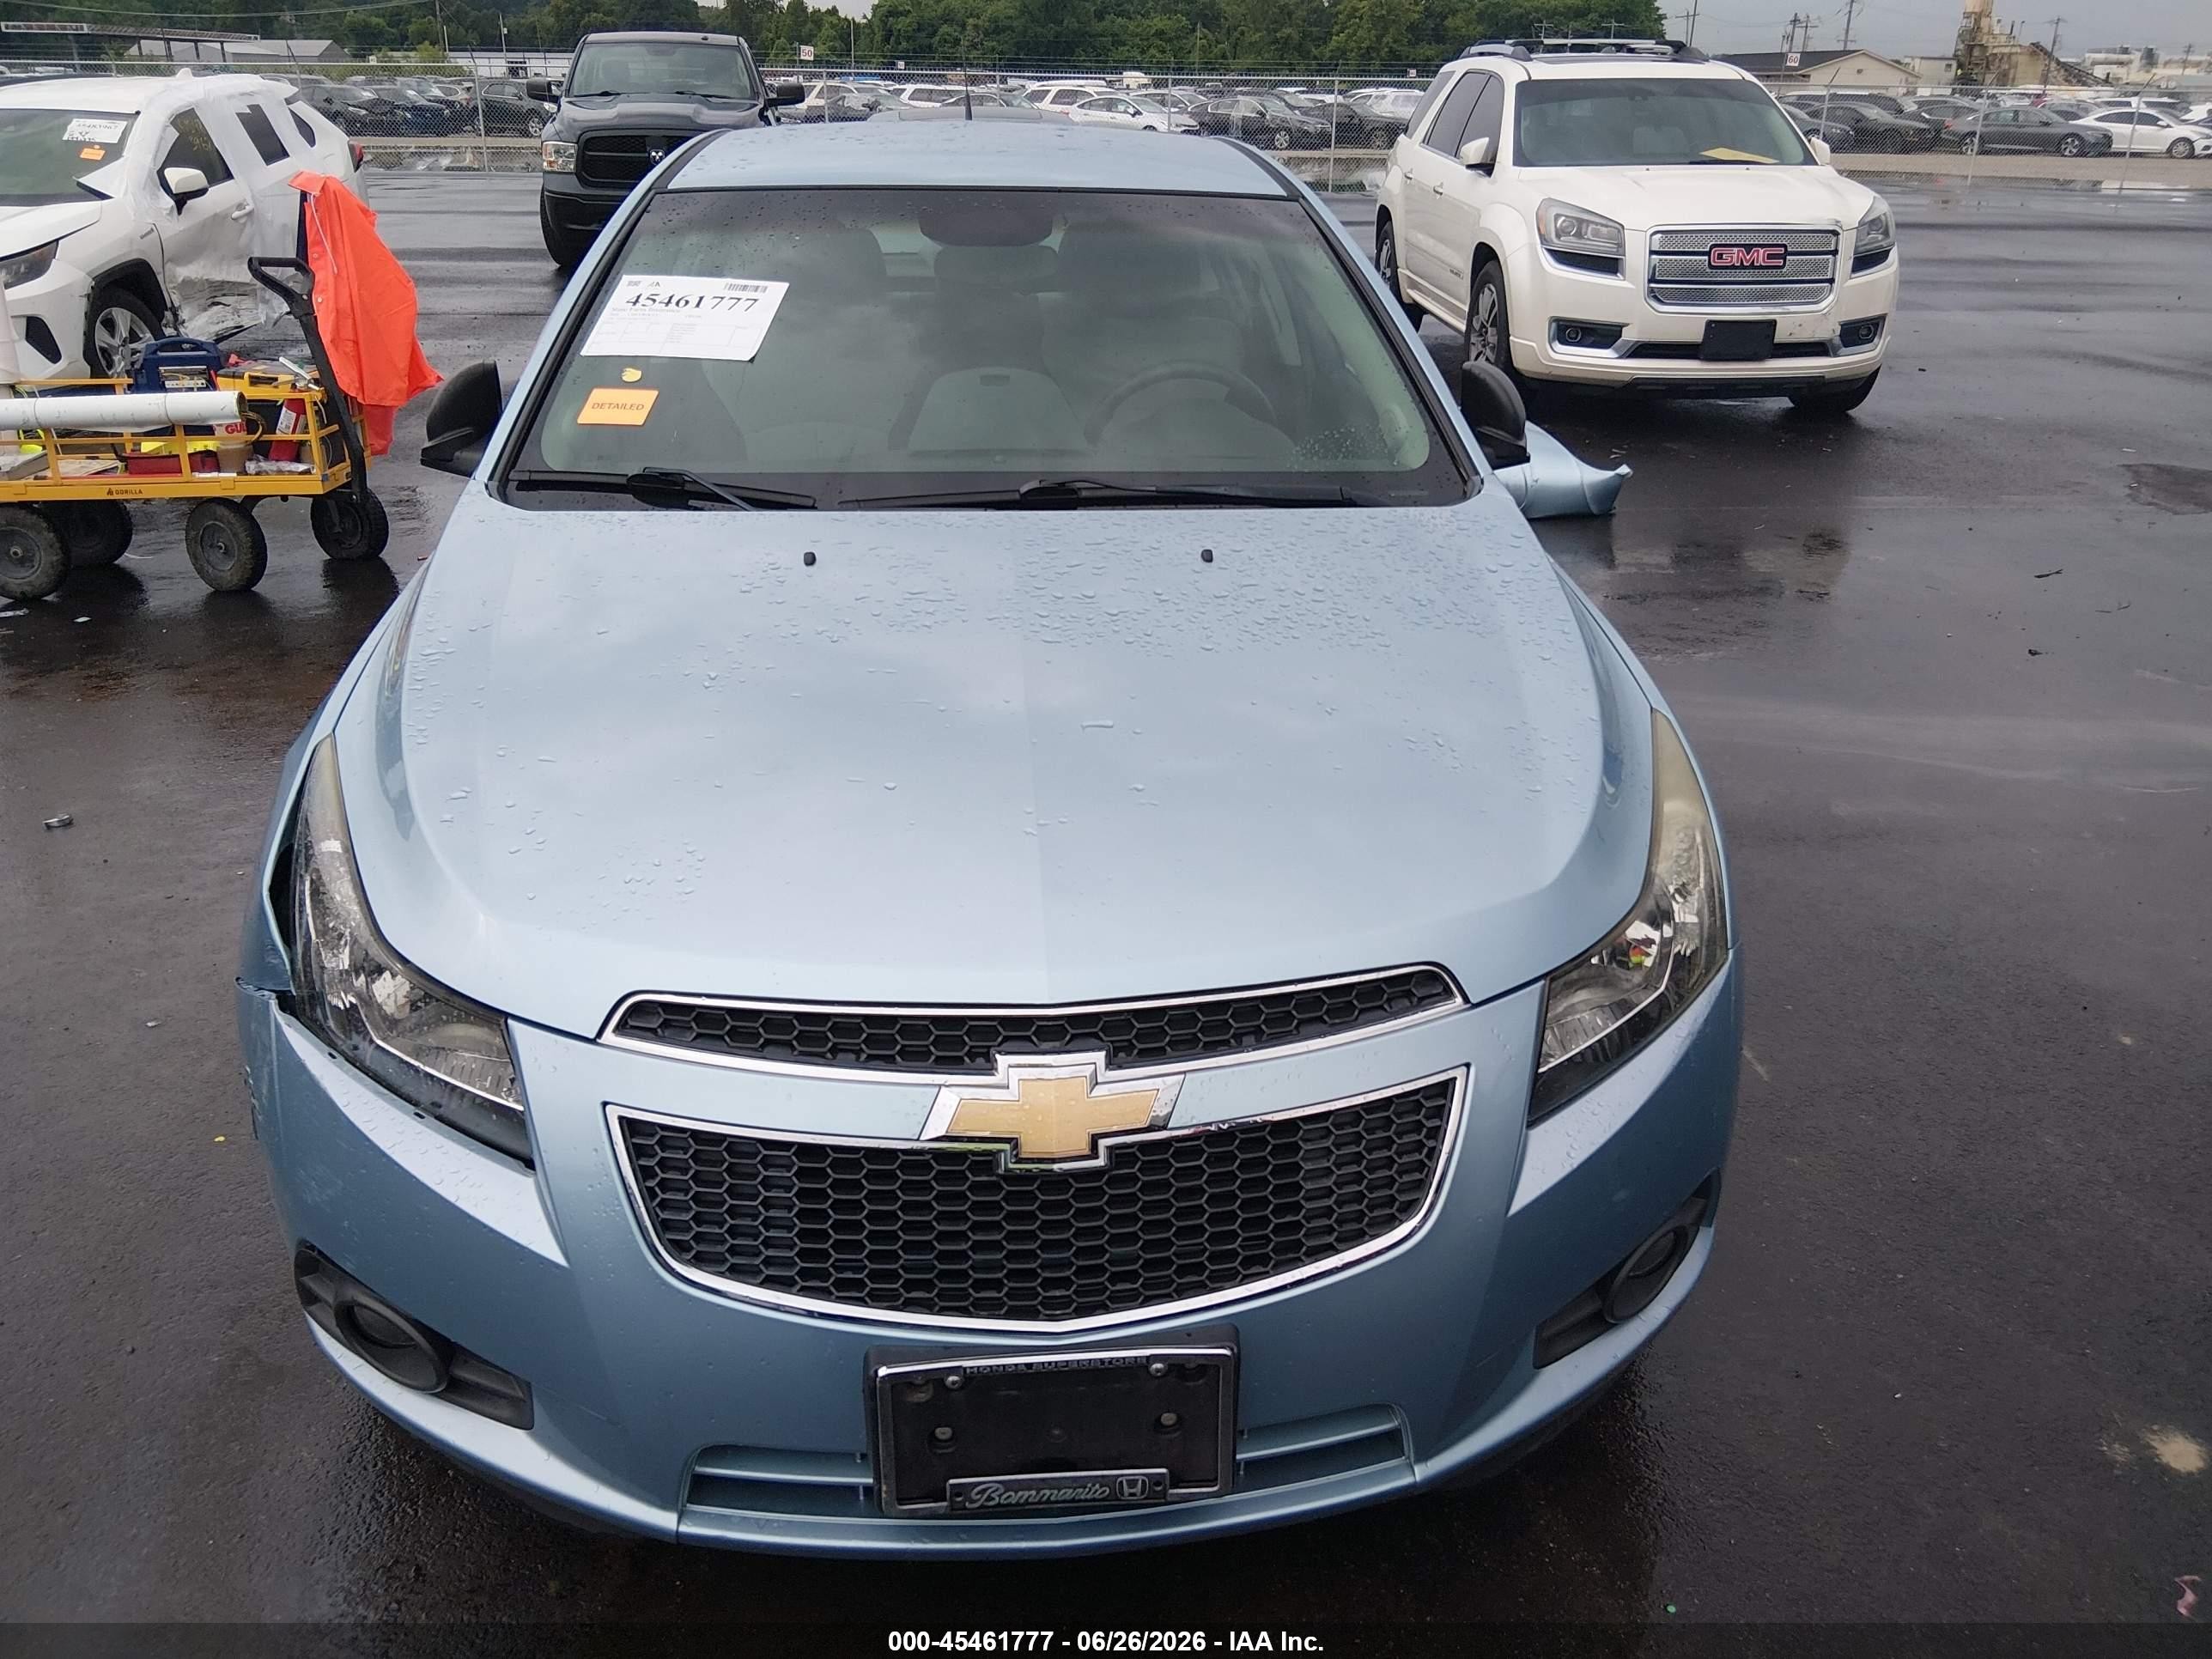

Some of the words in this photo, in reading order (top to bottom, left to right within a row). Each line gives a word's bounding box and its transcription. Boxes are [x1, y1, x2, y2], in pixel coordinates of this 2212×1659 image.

[1788, 55, 1799, 64] 60
[1711, 247, 1784, 266] GMC
[626, 293, 759, 312] 45461777
[591, 402, 645, 410] DETAILED
[966, 1364, 1027, 1375] HONDA
[965, 1482, 1111, 1509] Bommarito
